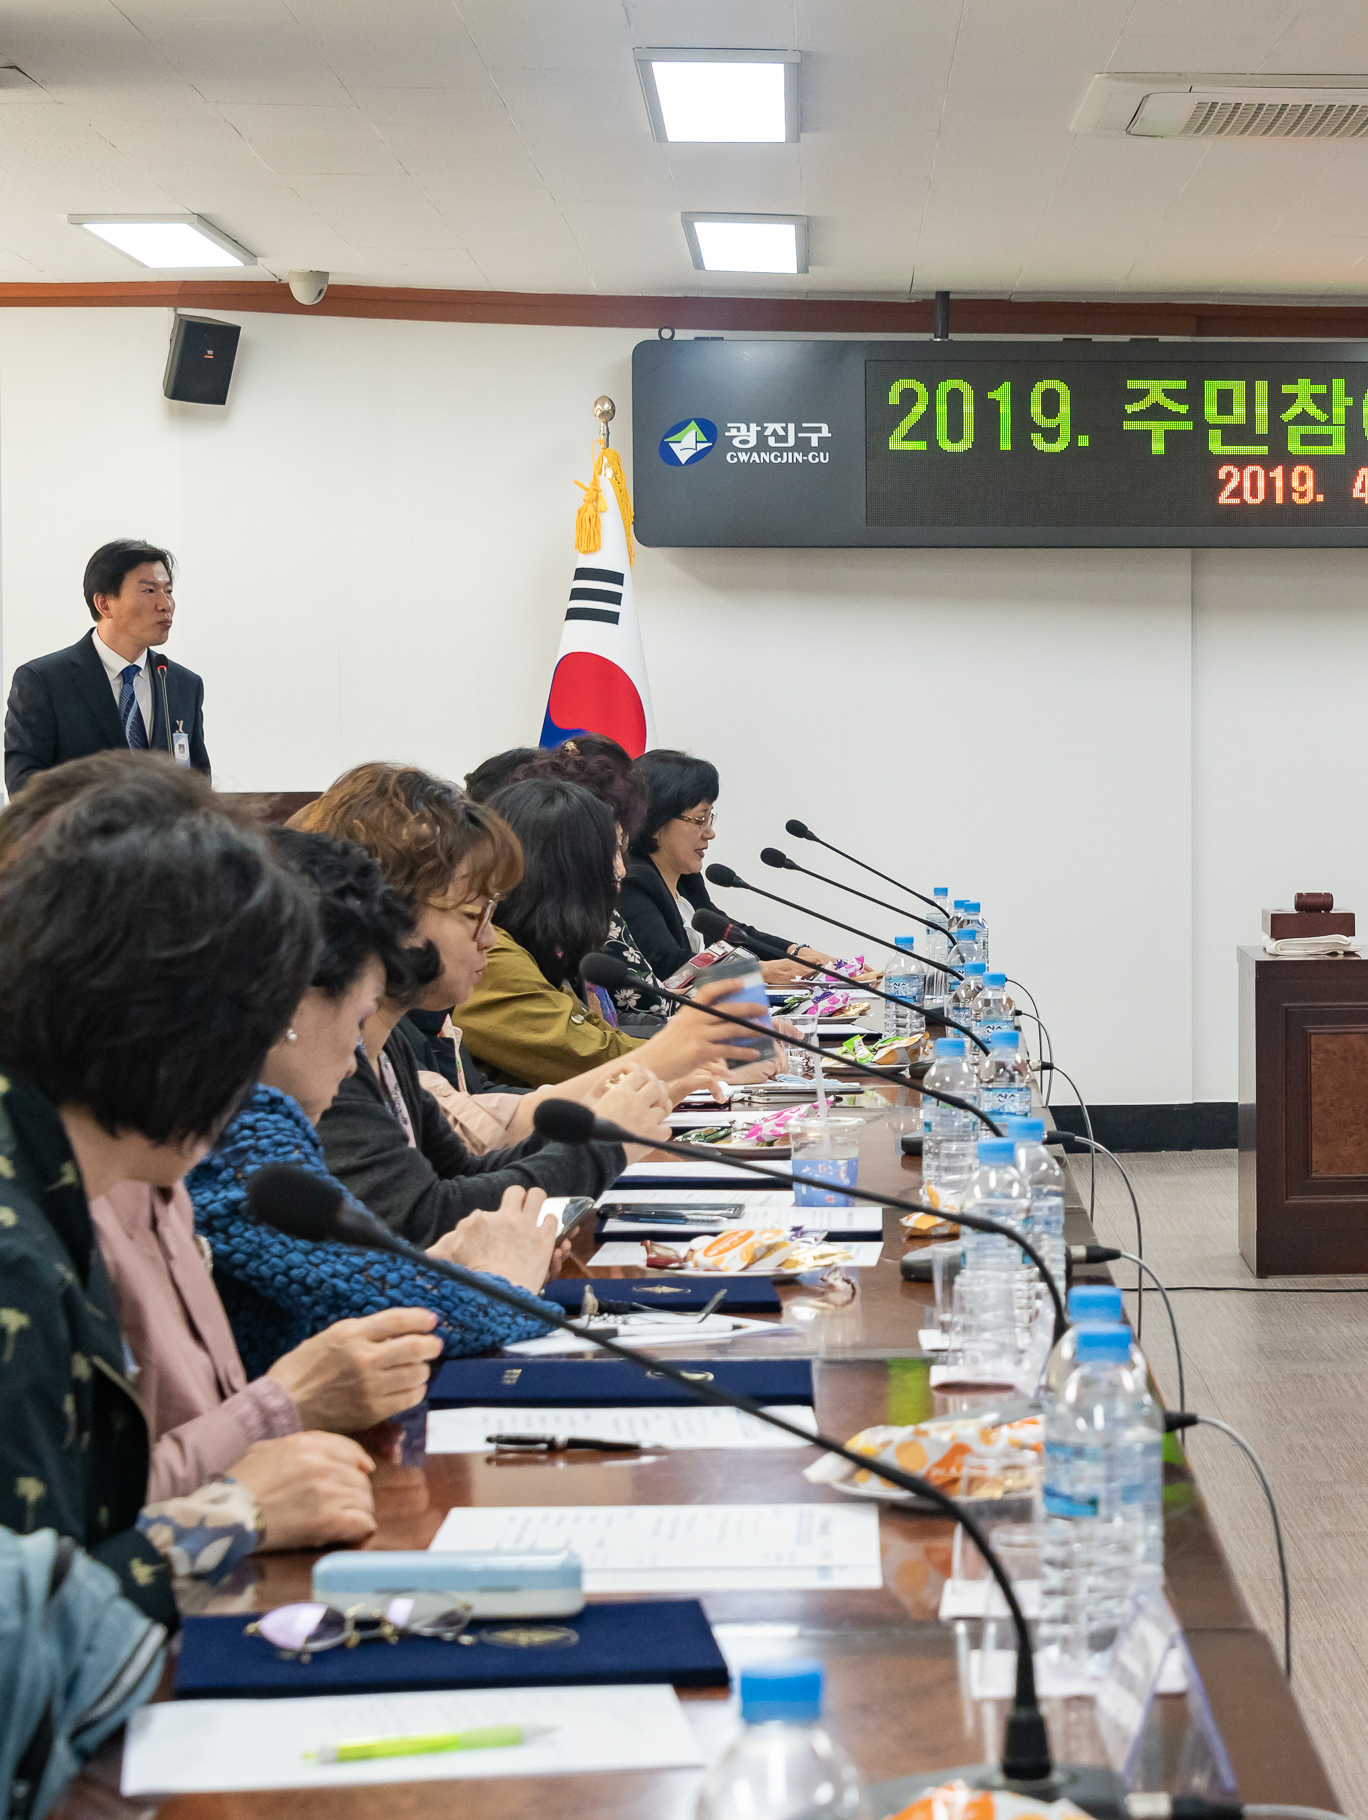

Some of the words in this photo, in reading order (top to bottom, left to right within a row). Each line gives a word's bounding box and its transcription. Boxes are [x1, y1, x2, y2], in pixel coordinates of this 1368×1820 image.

[888, 378, 1090, 453] 2019.
[725, 422, 832, 449] 광진구
[726, 451, 830, 464] GWANGJIN-GU
[1218, 465, 1324, 505] 2019.
